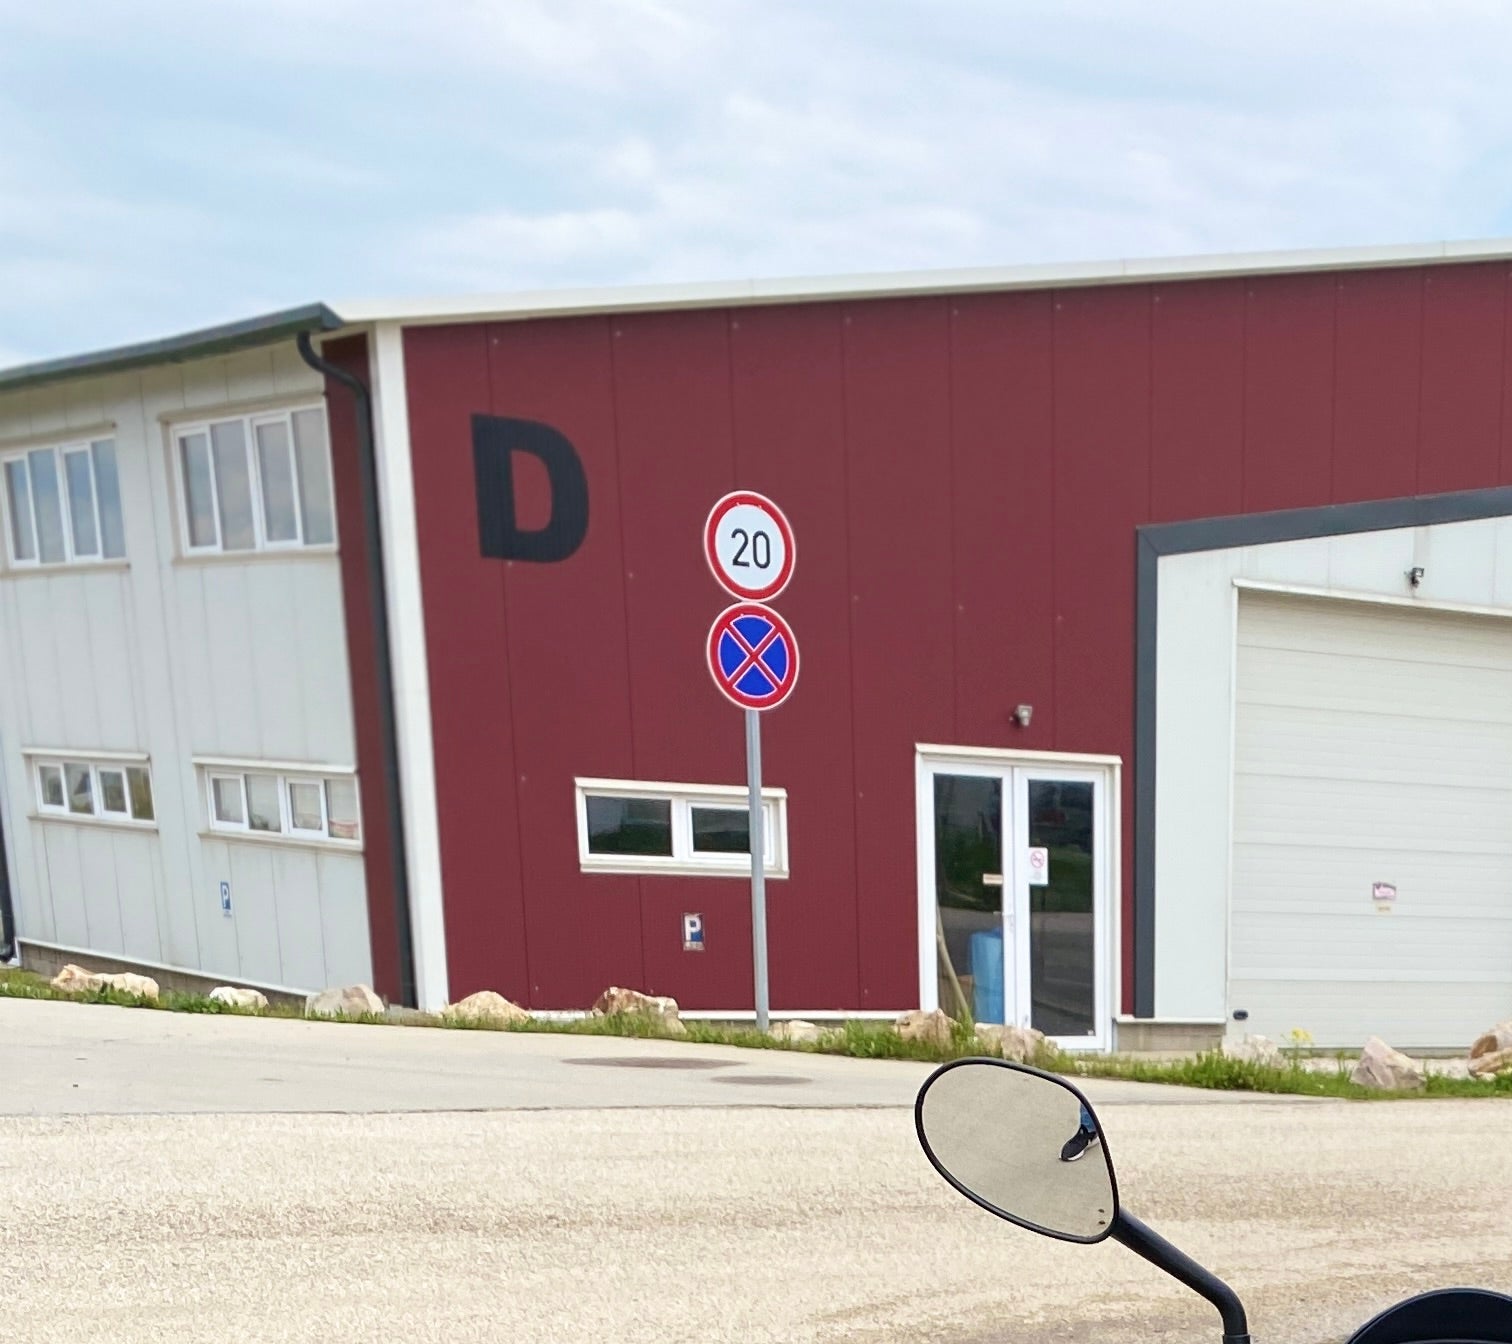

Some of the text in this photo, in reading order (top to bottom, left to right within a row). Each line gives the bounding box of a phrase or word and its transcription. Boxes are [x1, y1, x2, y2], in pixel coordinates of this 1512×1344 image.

[471, 414, 589, 563] D
[731, 528, 771, 569] 20
[222, 884, 229, 908] P
[685, 915, 701, 941] P
